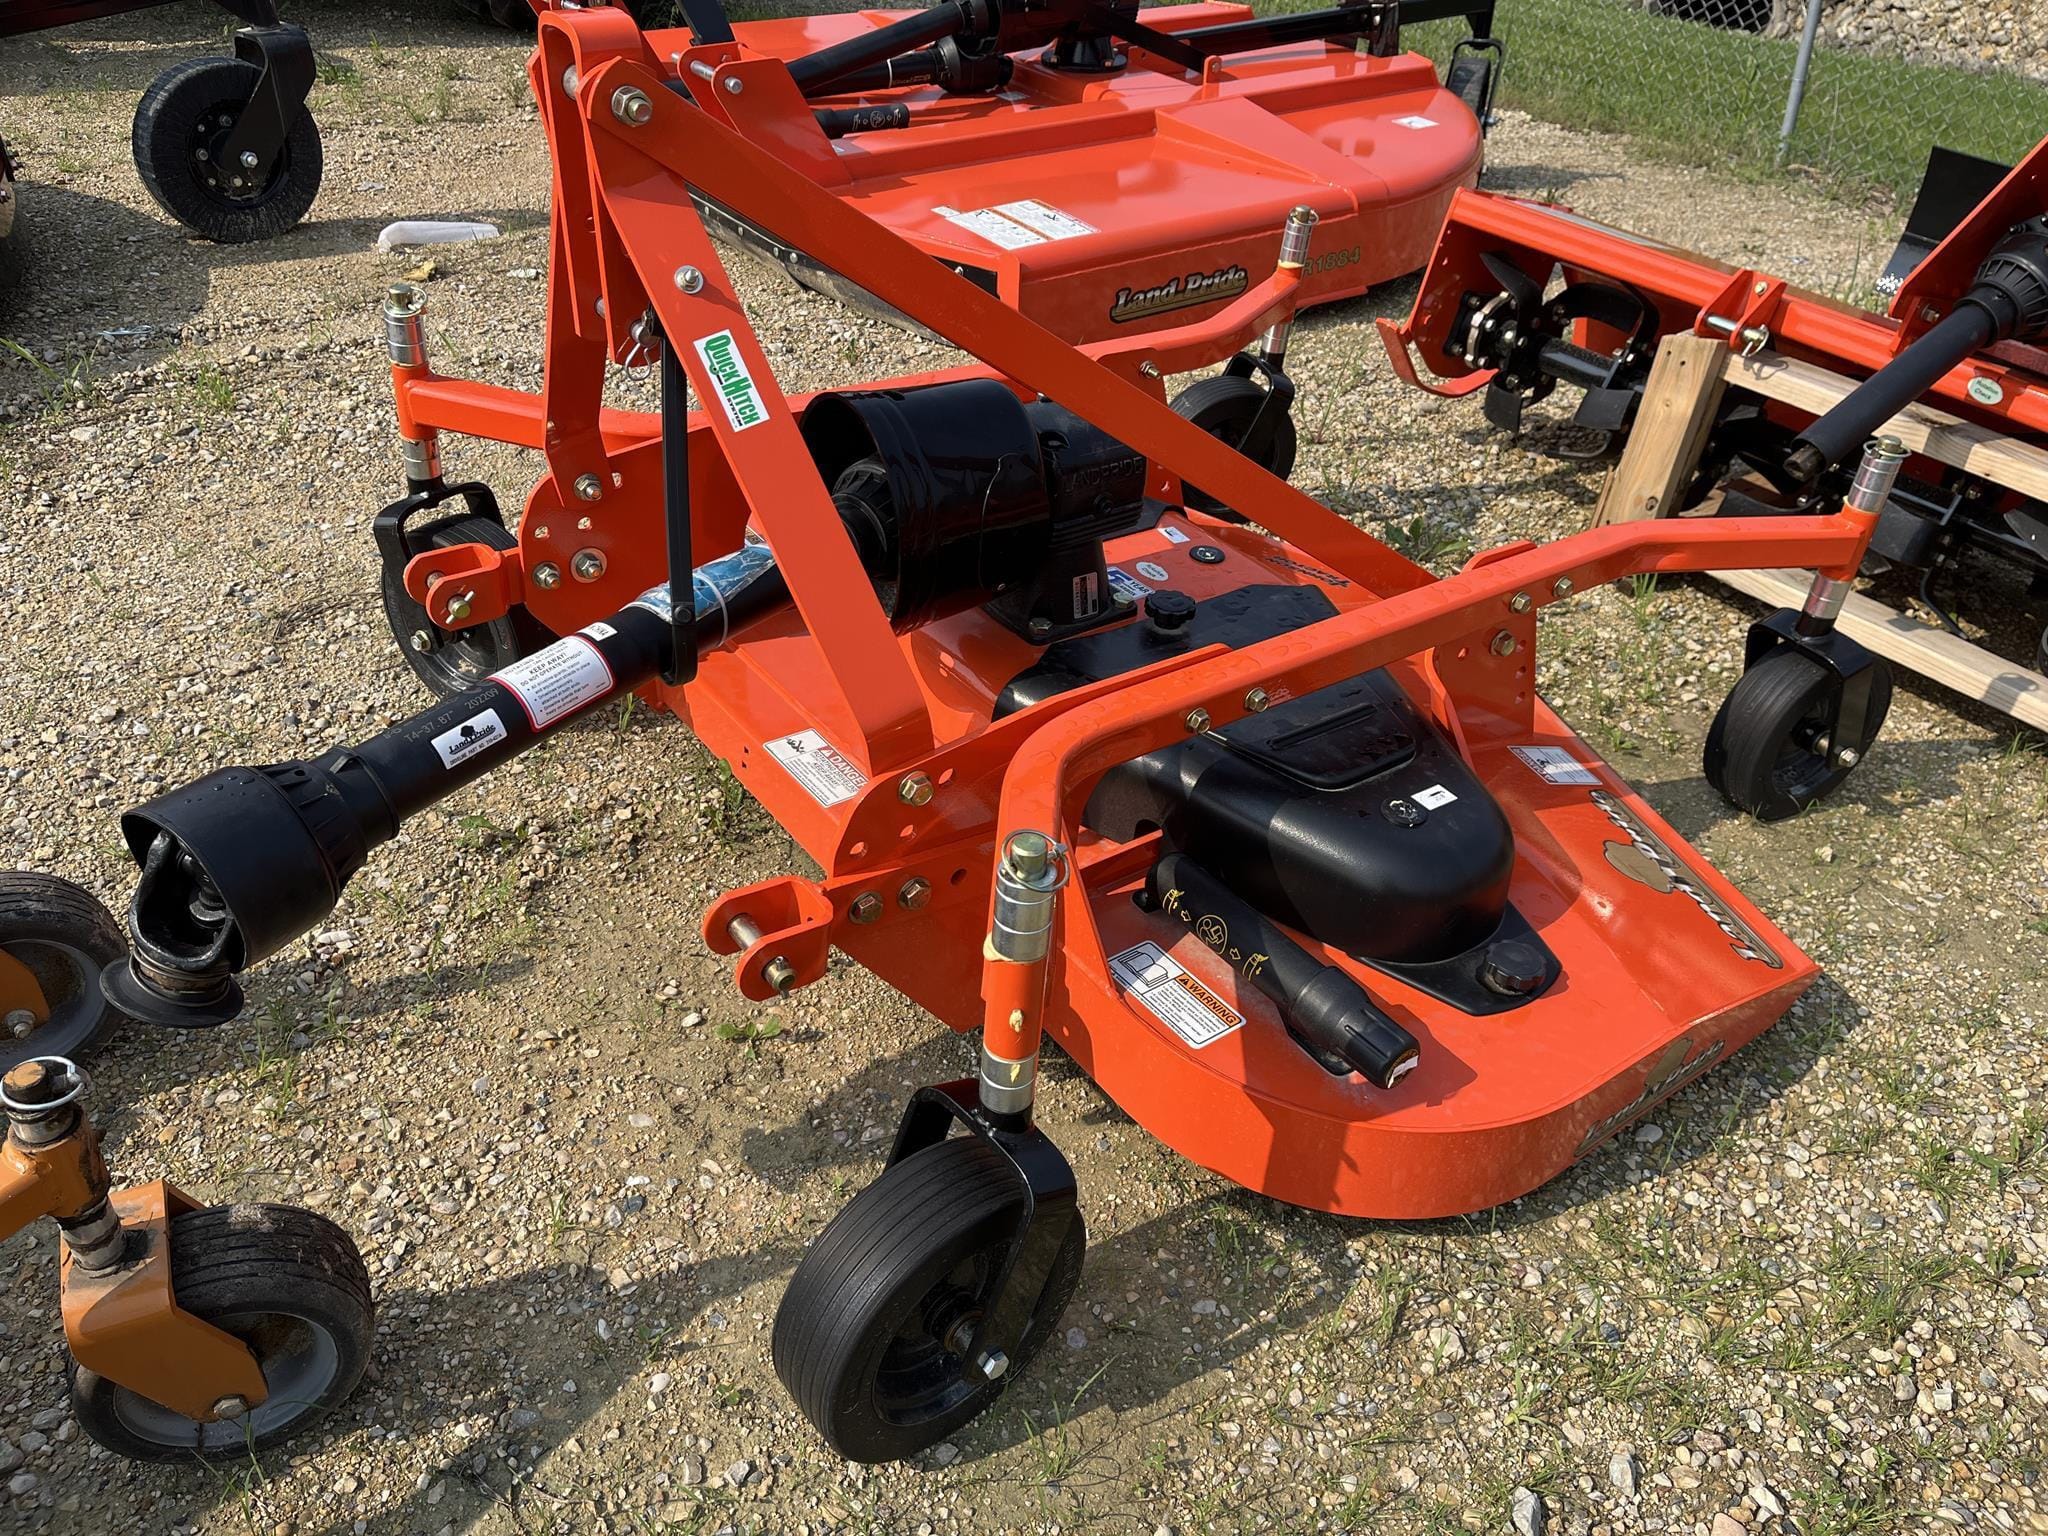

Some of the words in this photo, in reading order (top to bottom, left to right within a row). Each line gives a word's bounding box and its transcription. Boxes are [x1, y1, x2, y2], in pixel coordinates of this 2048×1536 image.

[1115, 279, 1178, 314] Land
[1183, 266, 1247, 300] Pride
[1130, 581, 1150, 593] YEAR
[528, 674, 539, 682] NOT
[539, 661, 561, 677] OPERATE
[529, 662, 546, 675] KEEP
[546, 651, 567, 665] AWAY!
[463, 686, 499, 711] 202209
[447, 737, 469, 752] Land
[473, 722, 495, 739] Pride
[467, 746, 478, 754] PART
[1189, 984, 1236, 1025] WARNING
